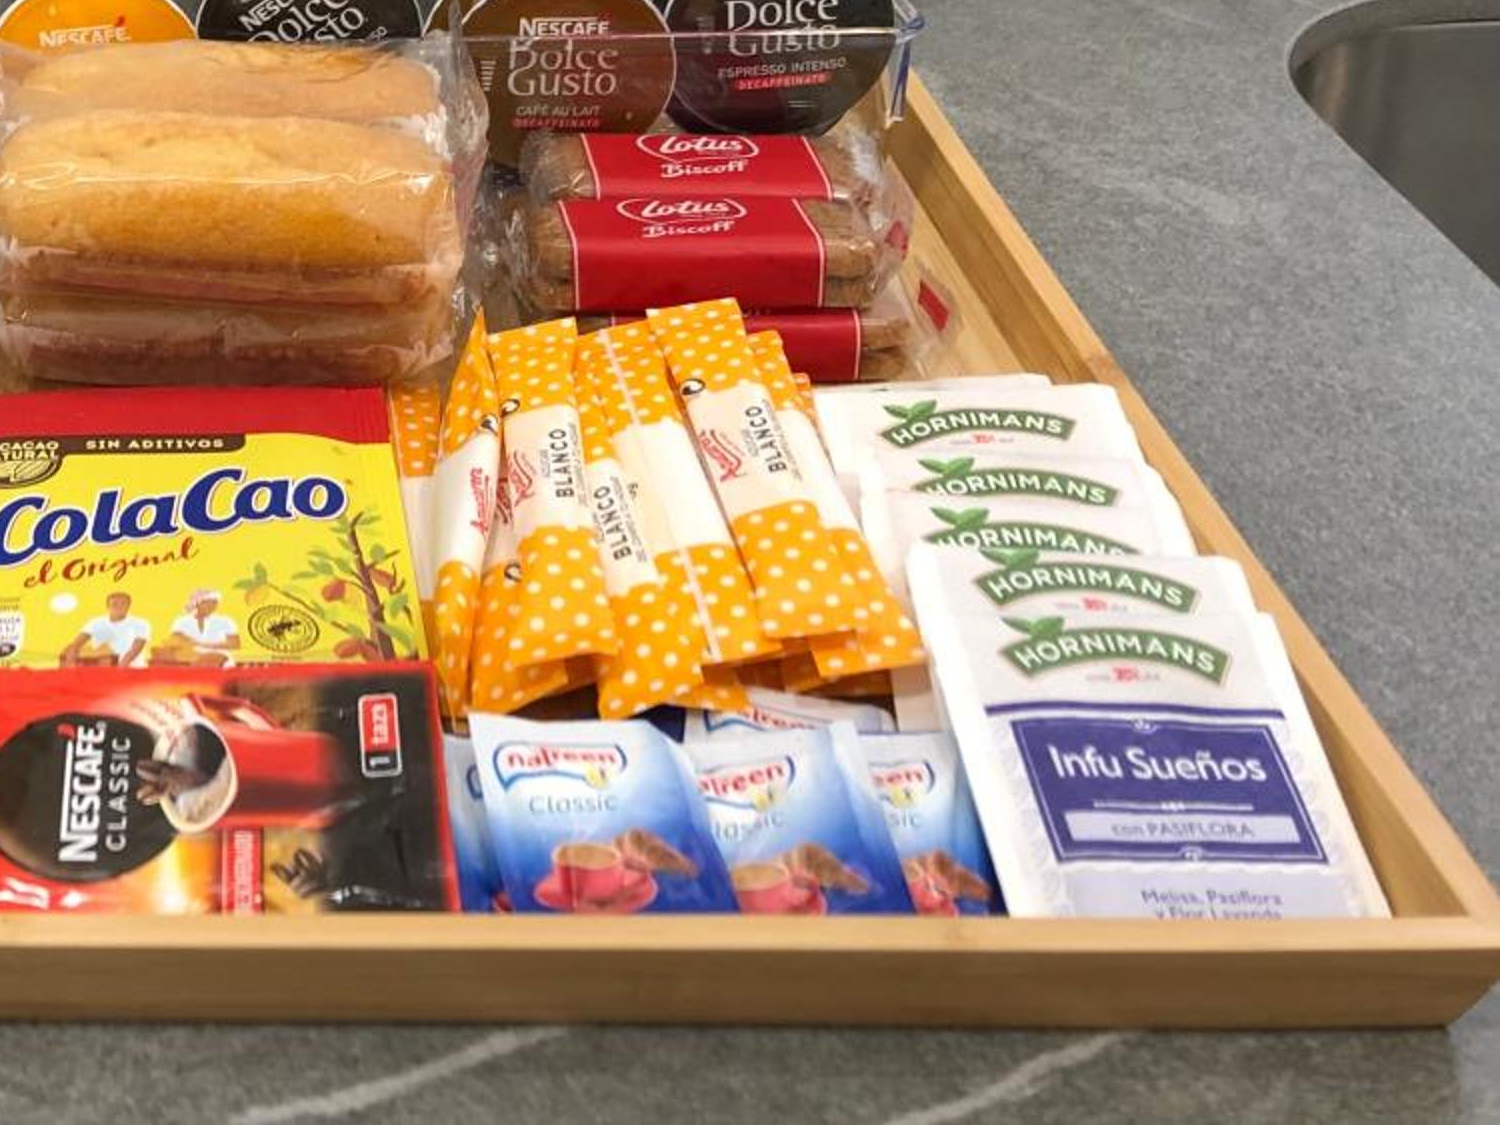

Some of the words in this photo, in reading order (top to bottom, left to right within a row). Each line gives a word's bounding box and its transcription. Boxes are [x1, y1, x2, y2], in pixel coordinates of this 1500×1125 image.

[509, 37, 619, 71] Dolce
[729, 22, 841, 57] Gusto
[507, 67, 617, 96] Gusto
[718, 63, 787, 78] ESPRESSO
[791, 56, 847, 73] INTENSO
[660, 135, 742, 154] Lotus
[661, 159, 748, 178] Biscoff
[642, 200, 729, 217] Lotus
[643, 219, 734, 239] Biscoff
[744, 406, 788, 473] BLANCO
[894, 409, 1063, 443] HORNIMANS
[0, 440, 59, 452] CACAO
[85, 439, 119, 450] SIN
[129, 439, 224, 450] ADITIVOS
[548, 428, 575, 499] BLANCO
[593, 485, 632, 561] BLANCO
[23, 568, 57, 588] el
[62, 536, 201, 584] Original
[987, 567, 1183, 607] HORNIMANS
[1014, 634, 1215, 675] HORNIMANS
[1047, 744, 1123, 781] Infu
[1128, 746, 1267, 782] Sueños
[105, 736, 132, 853] CLASSIC
[528, 793, 618, 815] Classic
[714, 811, 786, 842] lassic
